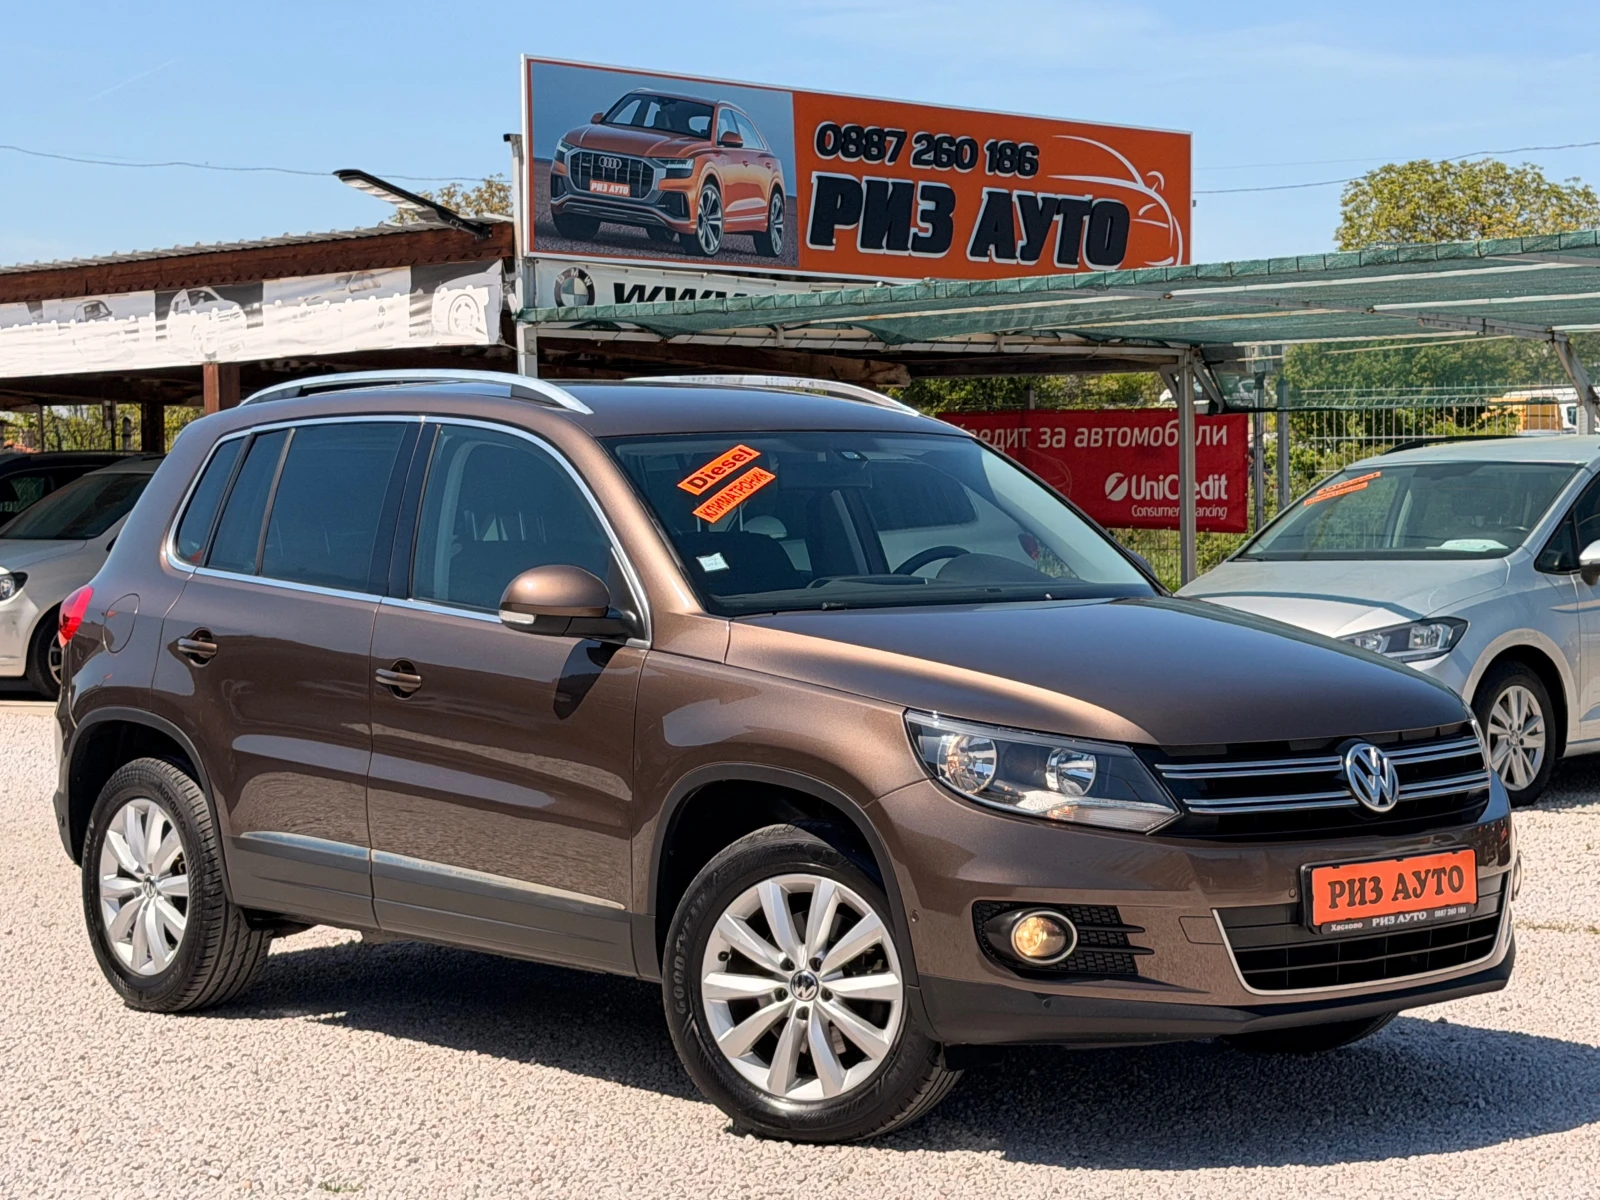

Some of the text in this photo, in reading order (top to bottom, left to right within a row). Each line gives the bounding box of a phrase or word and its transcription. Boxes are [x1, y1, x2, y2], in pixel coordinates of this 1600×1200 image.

[815, 121, 1040, 178] 0887 260 186
[591, 182, 629, 195] РИЗ АУТО
[807, 171, 1130, 270] РИЗ АУТО
[960, 419, 1228, 452] едит за автомобли
[687, 448, 753, 489] Diesel
[1131, 474, 1228, 500] UniCedit
[1131, 504, 1227, 520] Consumer ancing
[1328, 865, 1464, 909] РИЗ АУТО
[1372, 917, 1395, 927] РИЗ
[1397, 911, 1427, 924] АУТО
